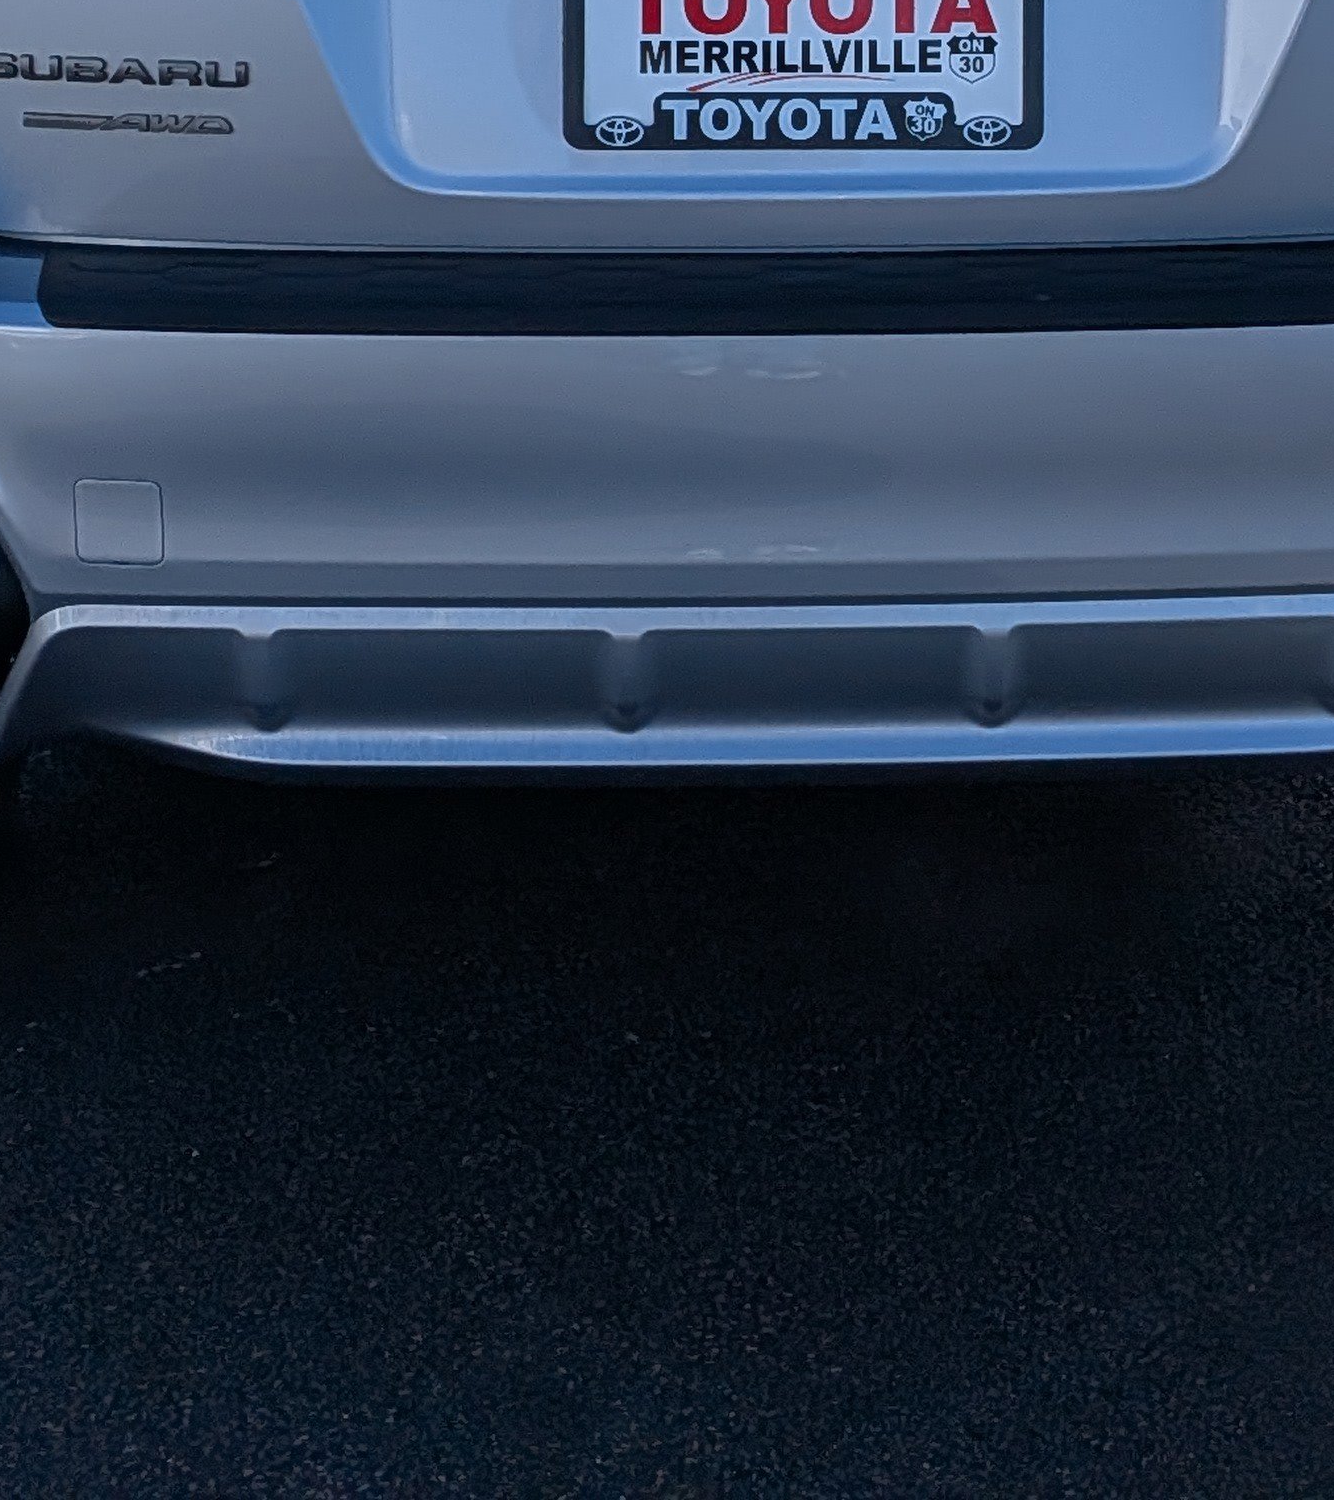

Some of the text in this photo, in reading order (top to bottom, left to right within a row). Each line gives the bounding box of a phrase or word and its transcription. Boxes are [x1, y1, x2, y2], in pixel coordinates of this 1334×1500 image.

[958, 39, 985, 52] ON
[639, 39, 942, 74] MERRILLVILLE
[958, 56, 985, 73] 30
[915, 104, 935, 117] ON
[99, 112, 234, 135] AWD
[661, 98, 897, 141] TOYOTA
[910, 117, 936, 134] 30
